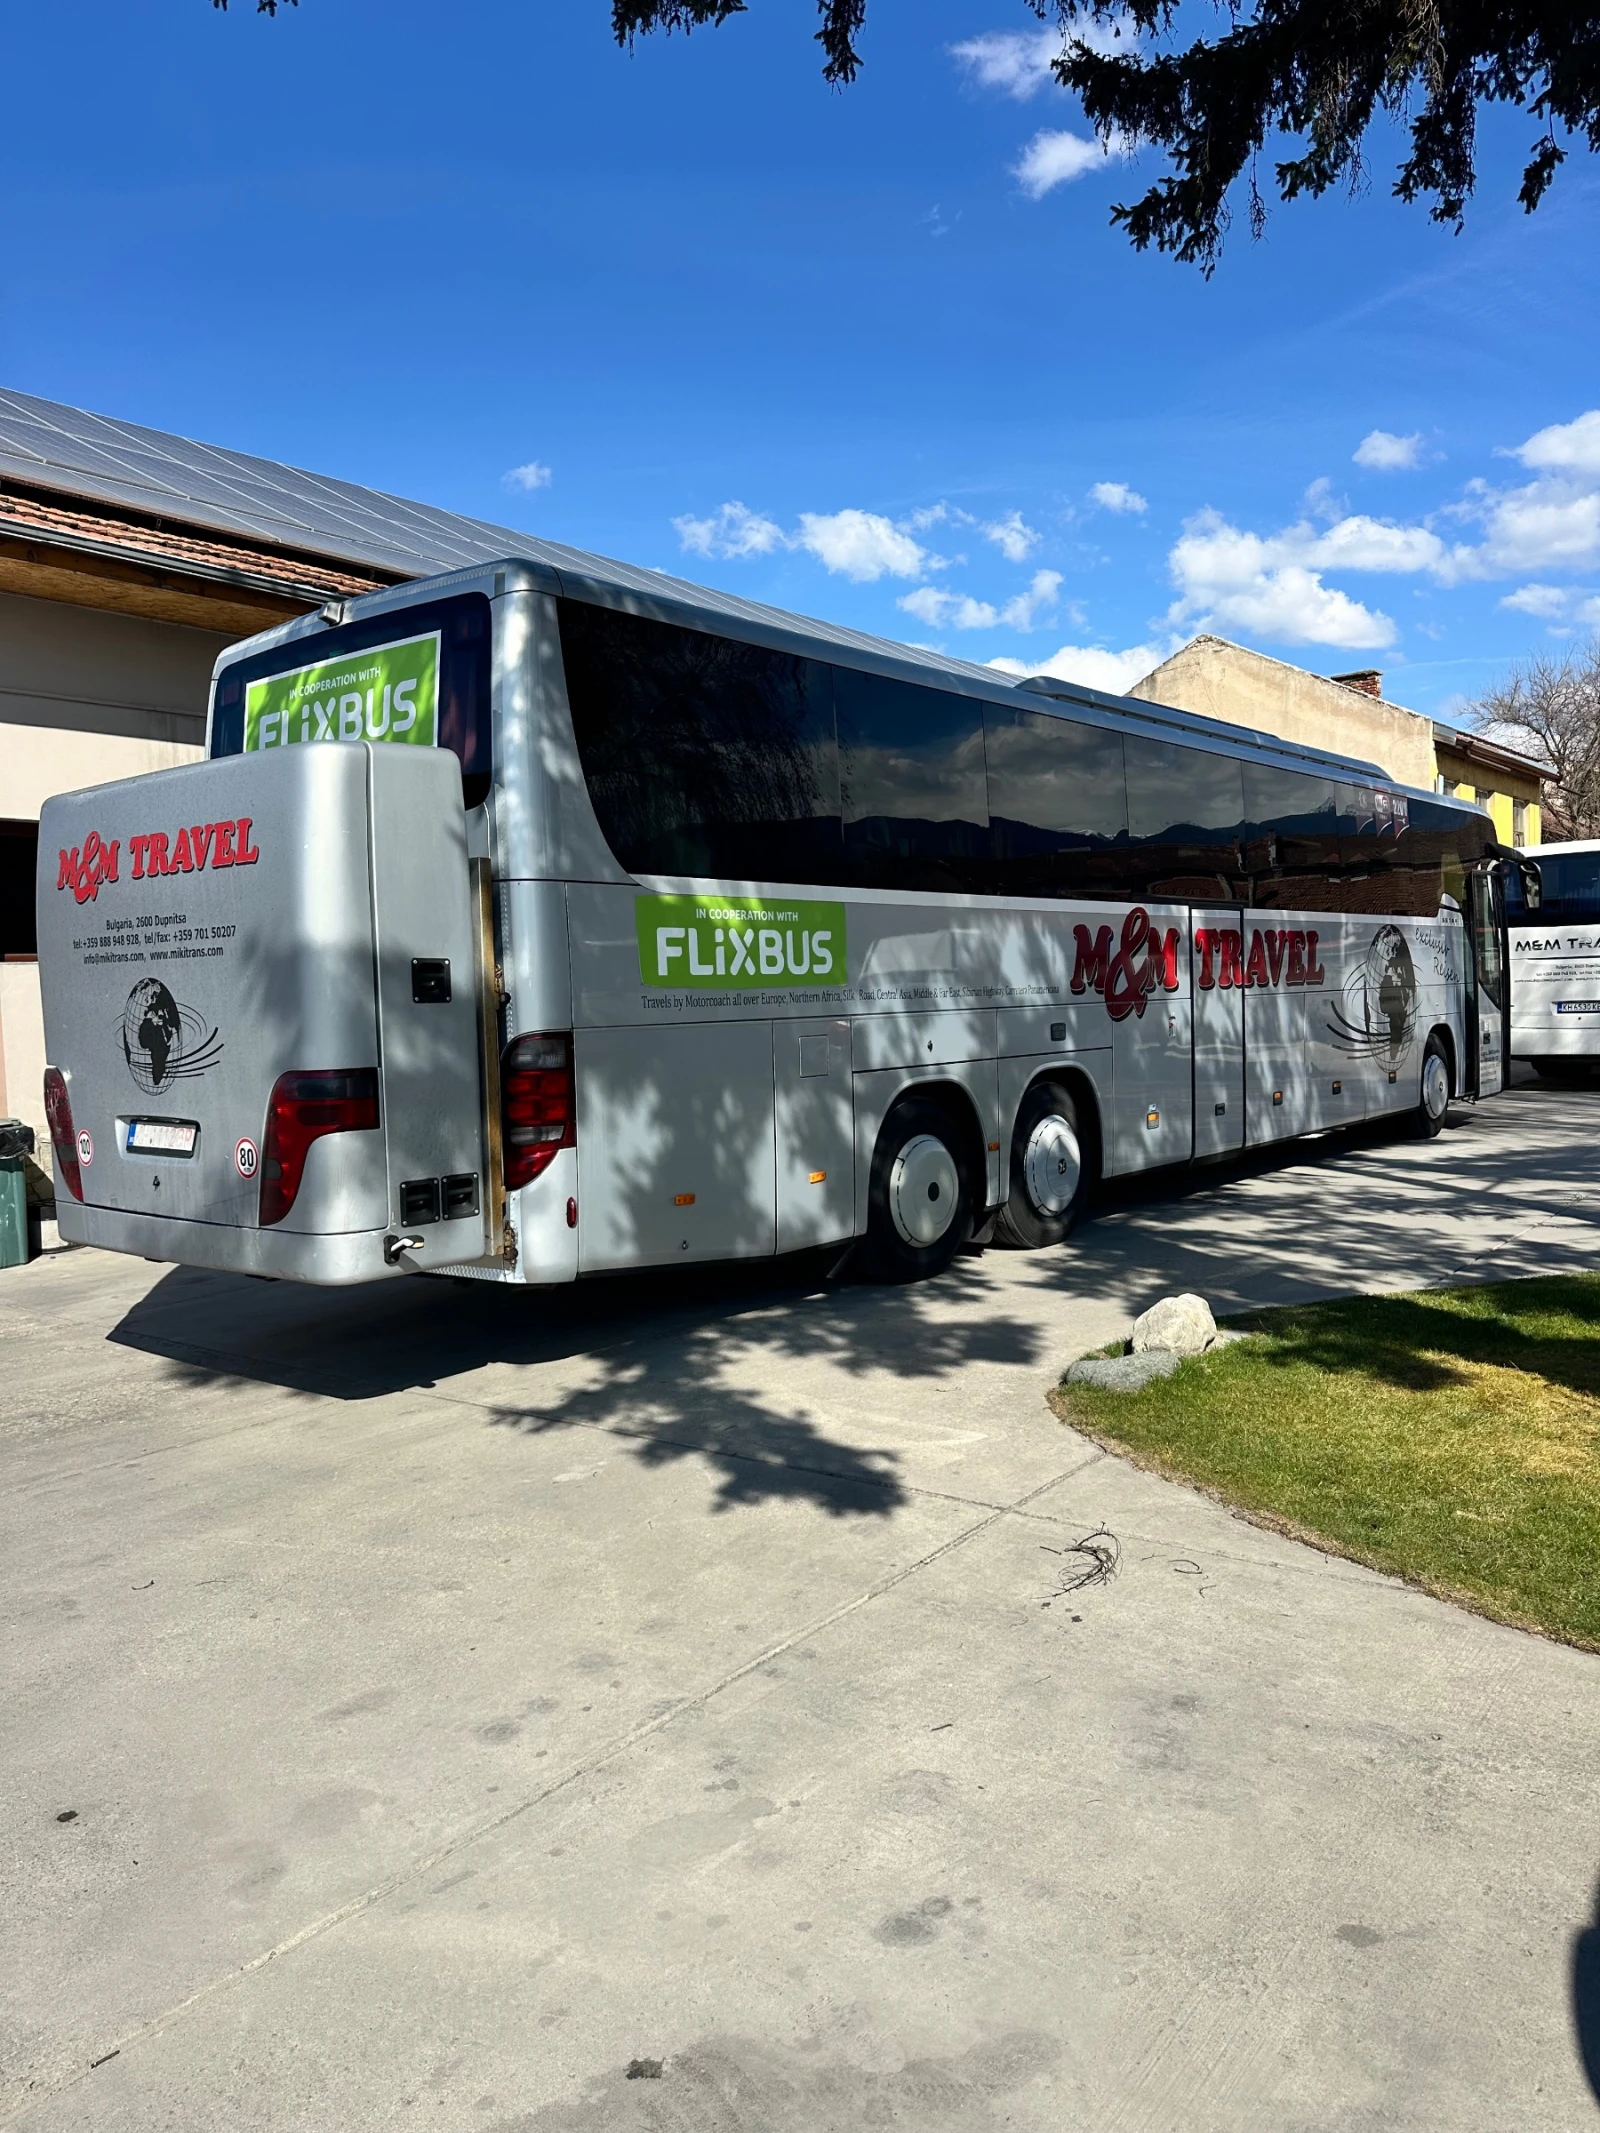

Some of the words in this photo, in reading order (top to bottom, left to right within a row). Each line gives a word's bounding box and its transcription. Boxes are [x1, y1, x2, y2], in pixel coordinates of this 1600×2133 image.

[289, 689, 297, 699] IN
[300, 674, 356, 697] COOPERATION
[359, 666, 382, 681] WITH
[57, 831, 121, 904] M&M
[129, 817, 260, 880] TRAVEL
[106, 919, 134, 932] Bulgaria,
[136, 916, 153, 928] 2600
[155, 913, 187, 926] Dupnitsa
[696, 908, 706, 919] IN
[708, 908, 775, 921] COOPERATION
[776, 911, 799, 922] WITH
[99, 934, 111, 947] 888
[112, 934, 125, 946] 948
[126, 933, 141, 946] 928,
[144, 931, 171, 945] tel/fax:
[173, 929, 193, 942] +359
[194, 927, 209, 940] 701
[211, 925, 236, 939] 50207
[150, 946, 224, 961] www.mikitrans.com
[1070, 906, 1181, 1022] M&M
[1195, 928, 1325, 991] TRAVEL
[641, 995, 672, 1010] Travels
[673, 995, 683, 1012] by
[685, 993, 731, 1008] Motorcoach
[732, 993, 742, 1006] all
[743, 994, 759, 1006] over
[761, 992, 788, 1008] Europe,
[789, 991, 820, 1004] Northern
[821, 990, 843, 1004] Africa,
[843, 988, 855, 1002] Silk
[858, 988, 876, 1001] Road,
[899, 988, 912, 1000] Asia,
[914, 987, 933, 999] Middle
[240, 1147, 254, 1168] 80
